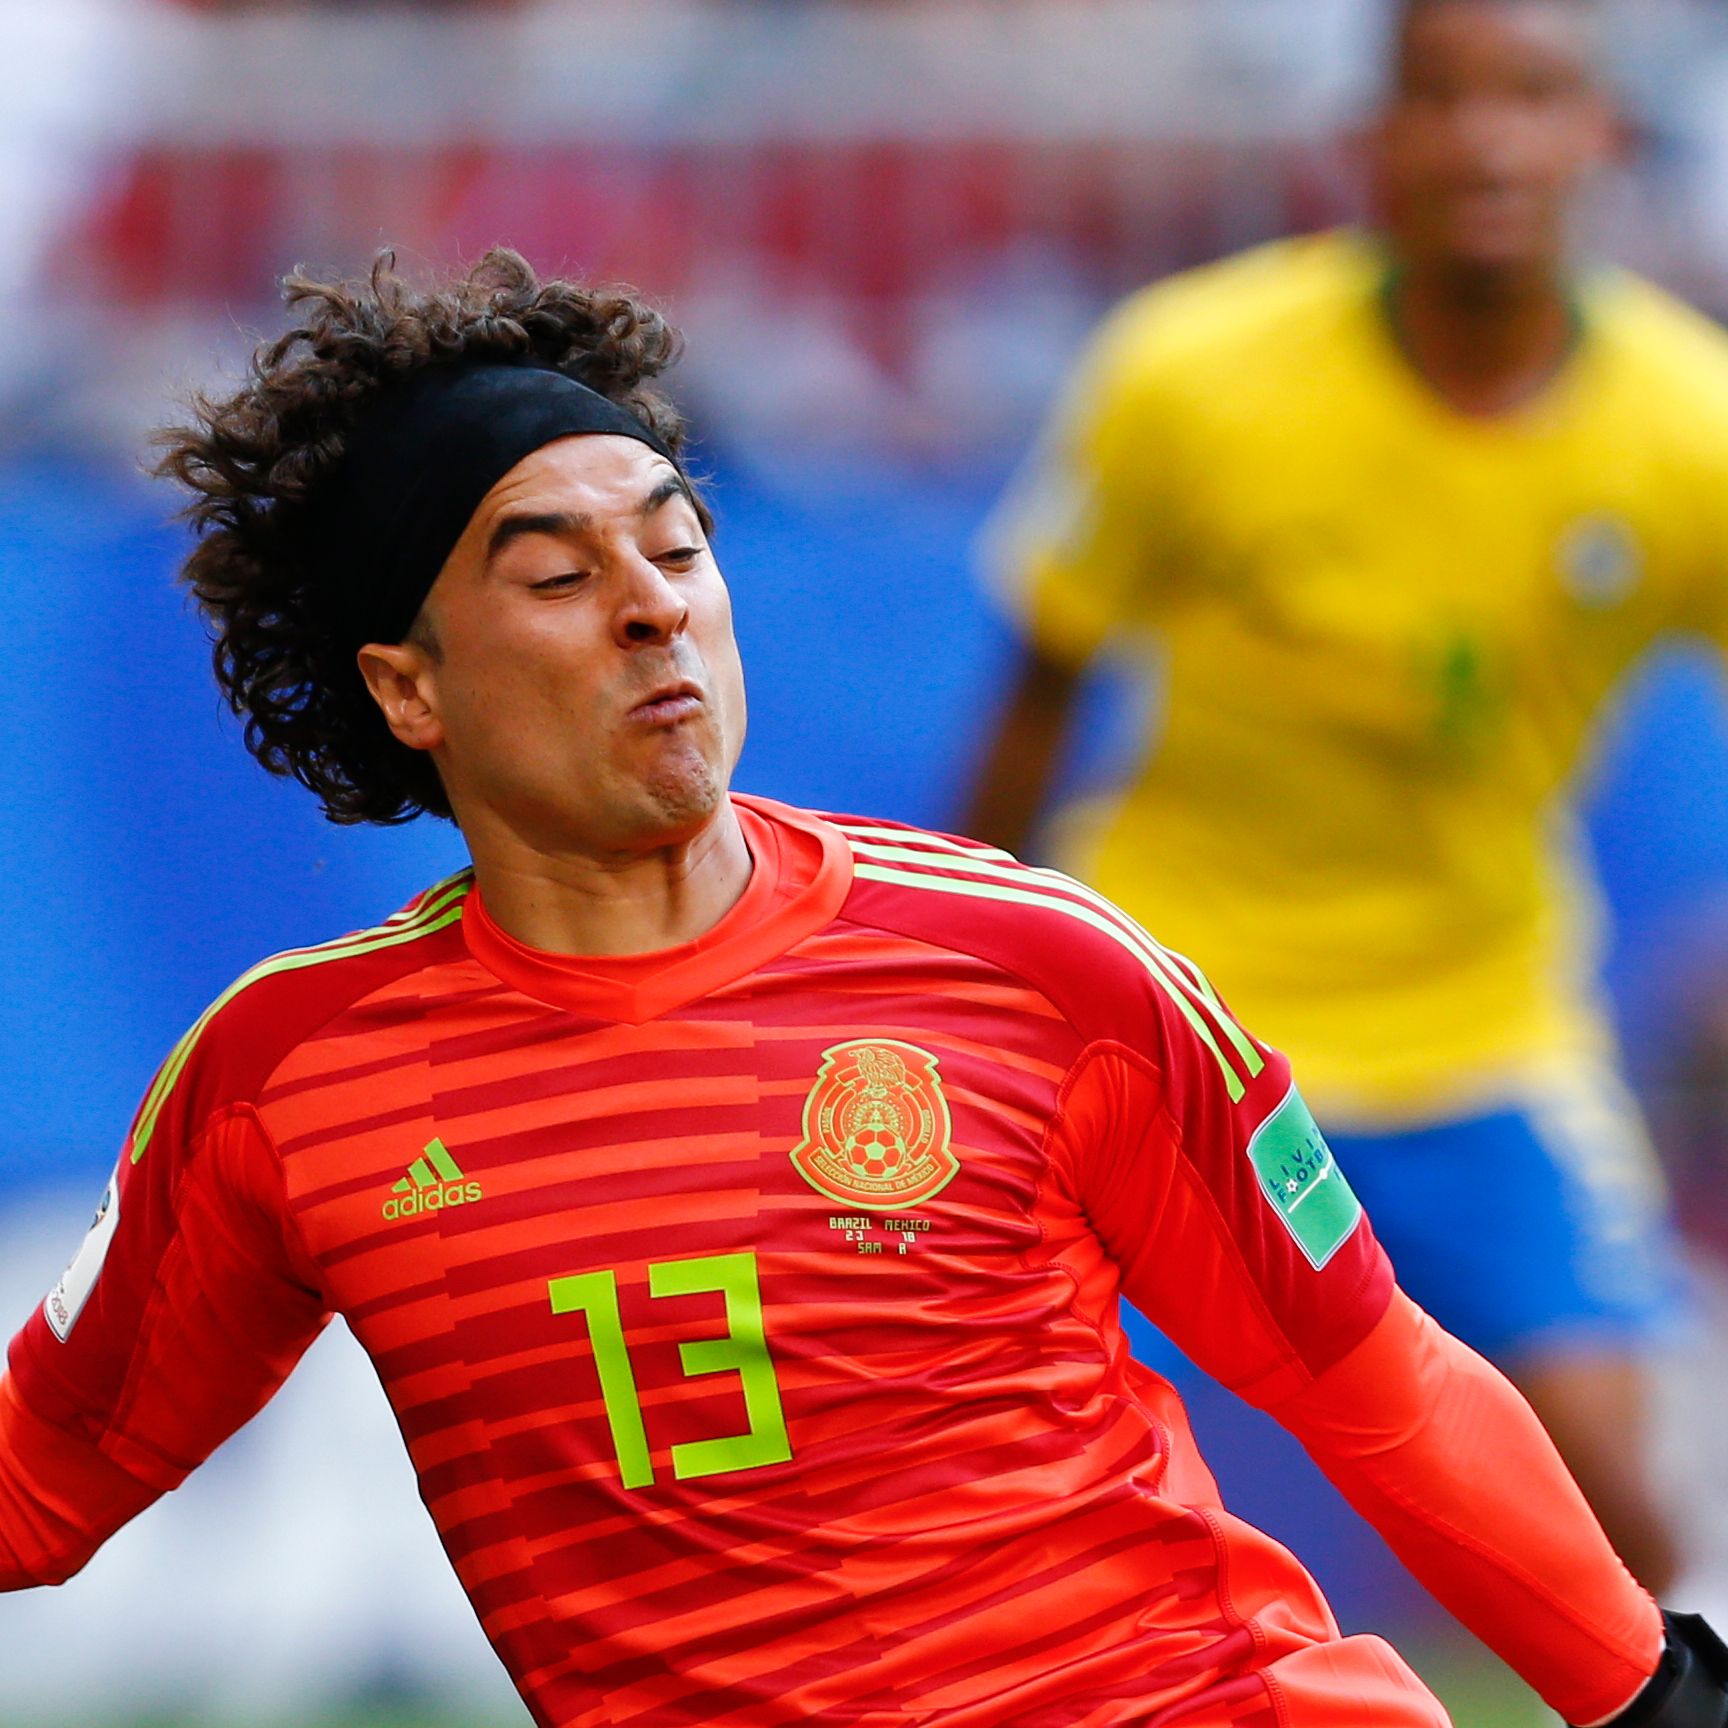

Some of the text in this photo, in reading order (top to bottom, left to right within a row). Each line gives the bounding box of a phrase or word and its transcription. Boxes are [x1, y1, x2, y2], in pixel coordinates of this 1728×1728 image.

[382, 1178, 482, 1221] adidas
[829, 1217, 931, 1231] BRAZIL MEXICO
[548, 1251, 792, 1490] 13
